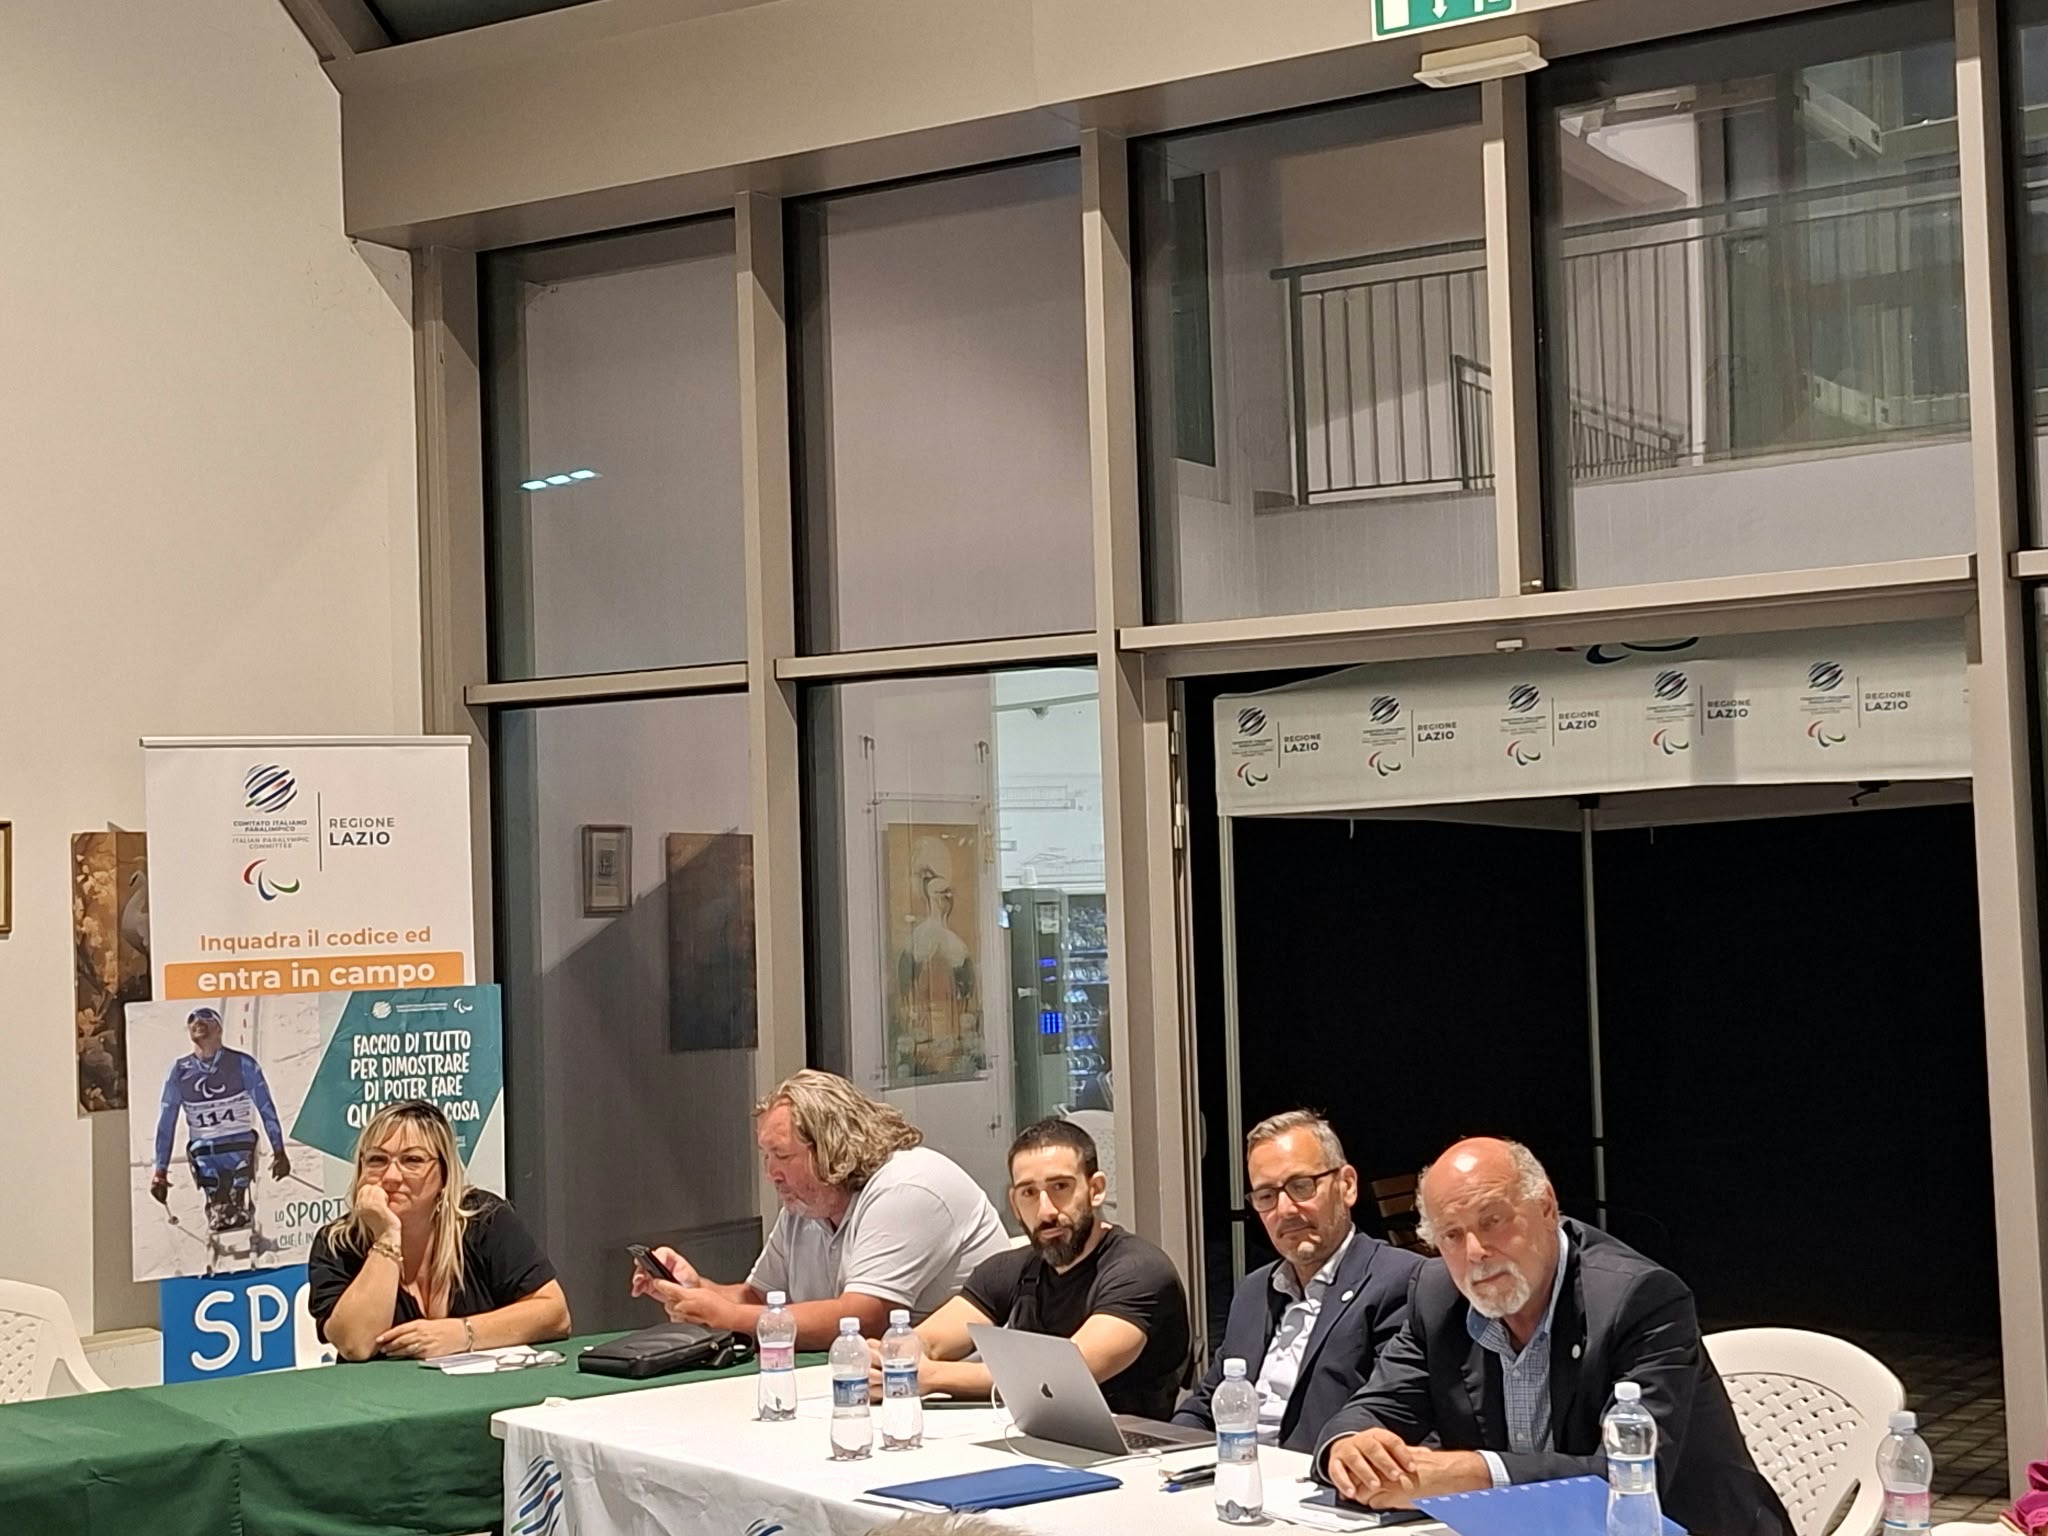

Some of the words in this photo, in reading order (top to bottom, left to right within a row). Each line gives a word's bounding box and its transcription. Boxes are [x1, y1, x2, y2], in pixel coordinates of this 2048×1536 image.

[1865, 691, 1911, 700] REGIONE
[1707, 708, 1748, 719] LAZIO
[1864, 701, 1908, 712] LAZIO
[1417, 722, 1457, 731] REGIONE
[1558, 719, 1597, 731] LAZIO
[1418, 731, 1455, 742] LAZIO
[1284, 742, 1319, 753] LAZIO
[329, 817, 395, 828] REGIONE
[329, 832, 390, 846] LAZIO
[200, 932, 300, 953] Inquadra
[307, 930, 319, 946] il
[326, 928, 399, 946] codice
[405, 926, 431, 943] ed
[197, 967, 281, 992] entra
[291, 962, 320, 987] in
[329, 963, 436, 987] campo
[353, 1034, 400, 1057] FACCIO
[405, 1032, 420, 1054] DI
[423, 1030, 472, 1052] TUTTO
[351, 1058, 378, 1080] PER
[382, 1052, 471, 1078] DIMOSTRARE
[364, 1080, 380, 1102] DI
[384, 1077, 427, 1101] POTER
[431, 1074, 464, 1098] FARE
[443, 1100, 480, 1121] COSA
[196, 1108, 235, 1128] 114
[274, 1210, 285, 1223] LO
[286, 1197, 346, 1228] SPORT
